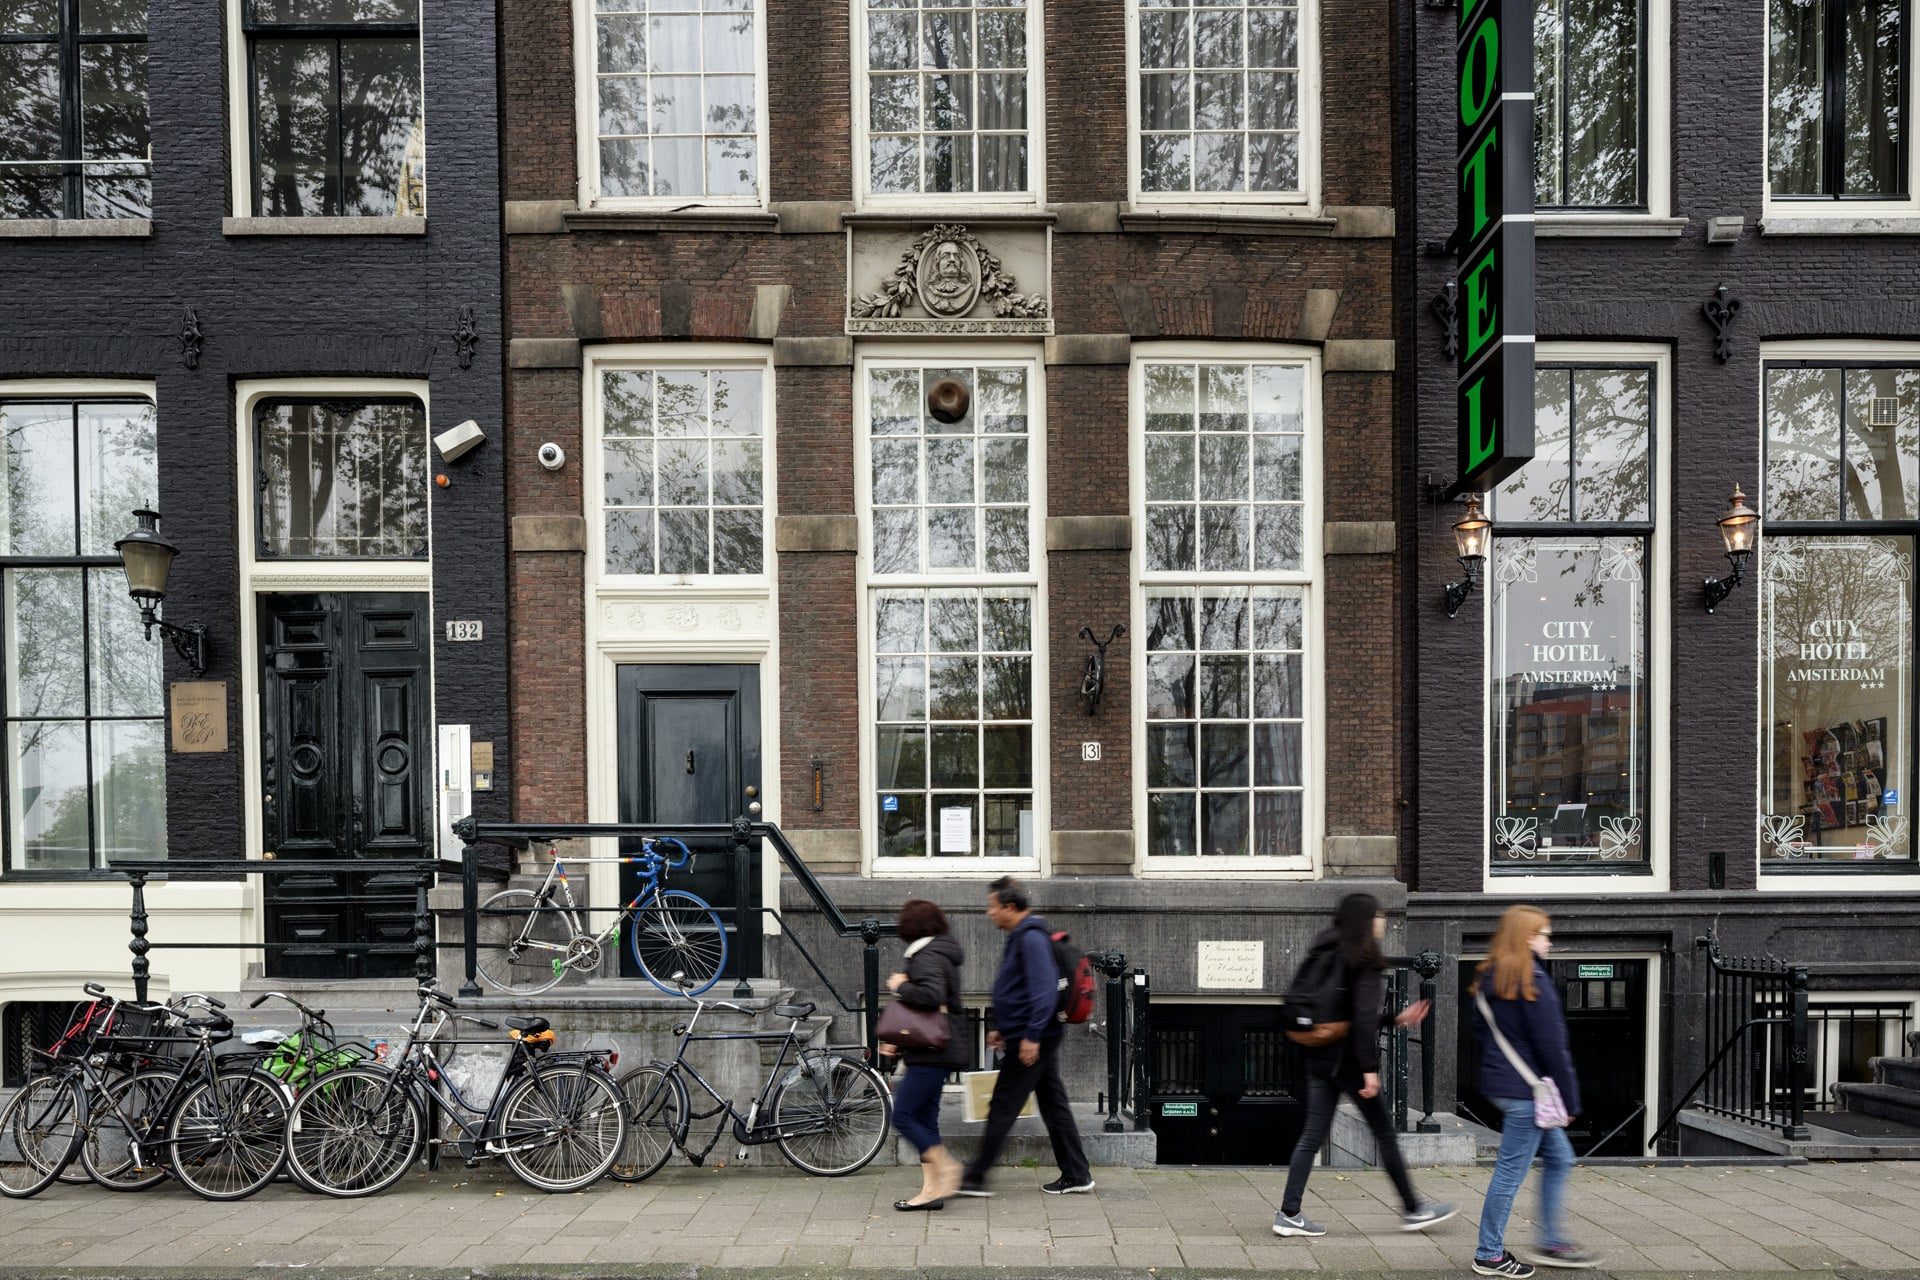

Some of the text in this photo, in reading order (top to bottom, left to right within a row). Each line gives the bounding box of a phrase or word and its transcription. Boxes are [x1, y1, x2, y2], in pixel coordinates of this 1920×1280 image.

[1459, 0, 1499, 475] OTEL
[451, 623, 478, 639] 132
[1542, 621, 1593, 639] CITY
[1810, 620, 1861, 637] CITY
[1533, 644, 1606, 662] HOTEL
[1800, 642, 1872, 660] HOTEL
[1520, 670, 1617, 683] AMSTERDAM
[1787, 668, 1885, 681] AMSTERDAM
[1083, 743, 1100, 759] 131
